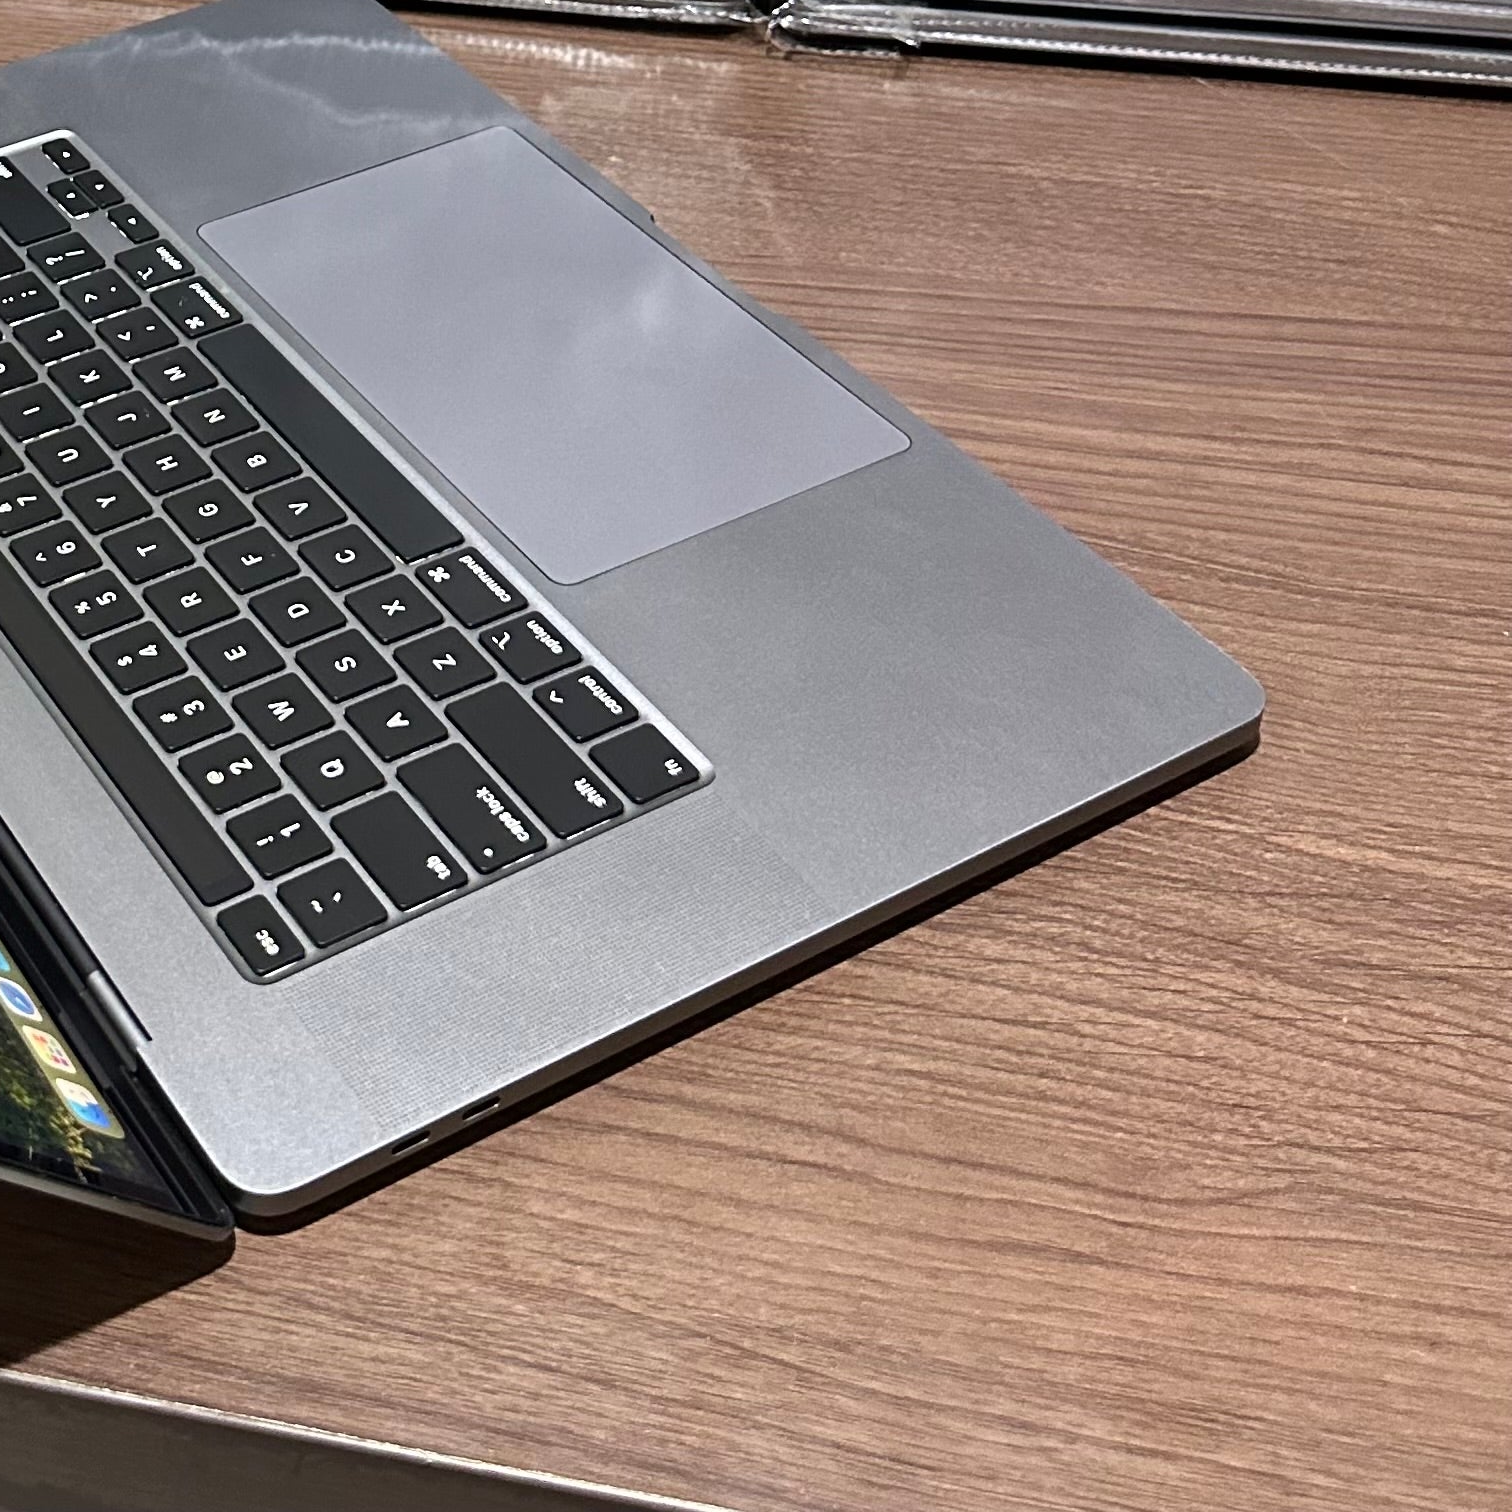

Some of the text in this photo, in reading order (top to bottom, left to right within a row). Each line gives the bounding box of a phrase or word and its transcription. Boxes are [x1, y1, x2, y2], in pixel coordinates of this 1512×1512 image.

[46, 329, 64, 343] L
[79, 369, 101, 384] K
[163, 365, 187, 382] M
[117, 413, 137, 422] J
[203, 408, 226, 424] N
[57, 448, 79, 463] U
[155, 455, 179, 471] H
[246, 454, 268, 469] B
[16, 495, 38, 507] 7
[95, 495, 117, 509] Y
[287, 502, 309, 516] V
[198, 503, 219, 517] G
[55, 541, 76, 555] 6
[136, 544, 157, 558] T
[240, 554, 263, 567] F
[334, 549, 356, 564] C
[458, 554, 512, 603] command
[95, 591, 117, 606] 5
[180, 591, 203, 609] R
[287, 603, 310, 619] D
[381, 599, 406, 617] X
[526, 619, 564, 655] option
[138, 644, 159, 657] 4
[223, 645, 247, 662] E
[334, 656, 357, 673] S
[431, 653, 457, 671] Z
[577, 674, 623, 716] control
[182, 699, 205, 716] 3
[267, 700, 295, 722] W
[385, 711, 410, 728] A
[228, 757, 254, 776] 2
[320, 758, 345, 779] Q
[664, 758, 683, 776] fn
[573, 777, 608, 809] shift
[475, 786, 530, 843] caps lock
[279, 822, 301, 838] 1
[426, 855, 451, 881] tab
[255, 929, 280, 956] esc
